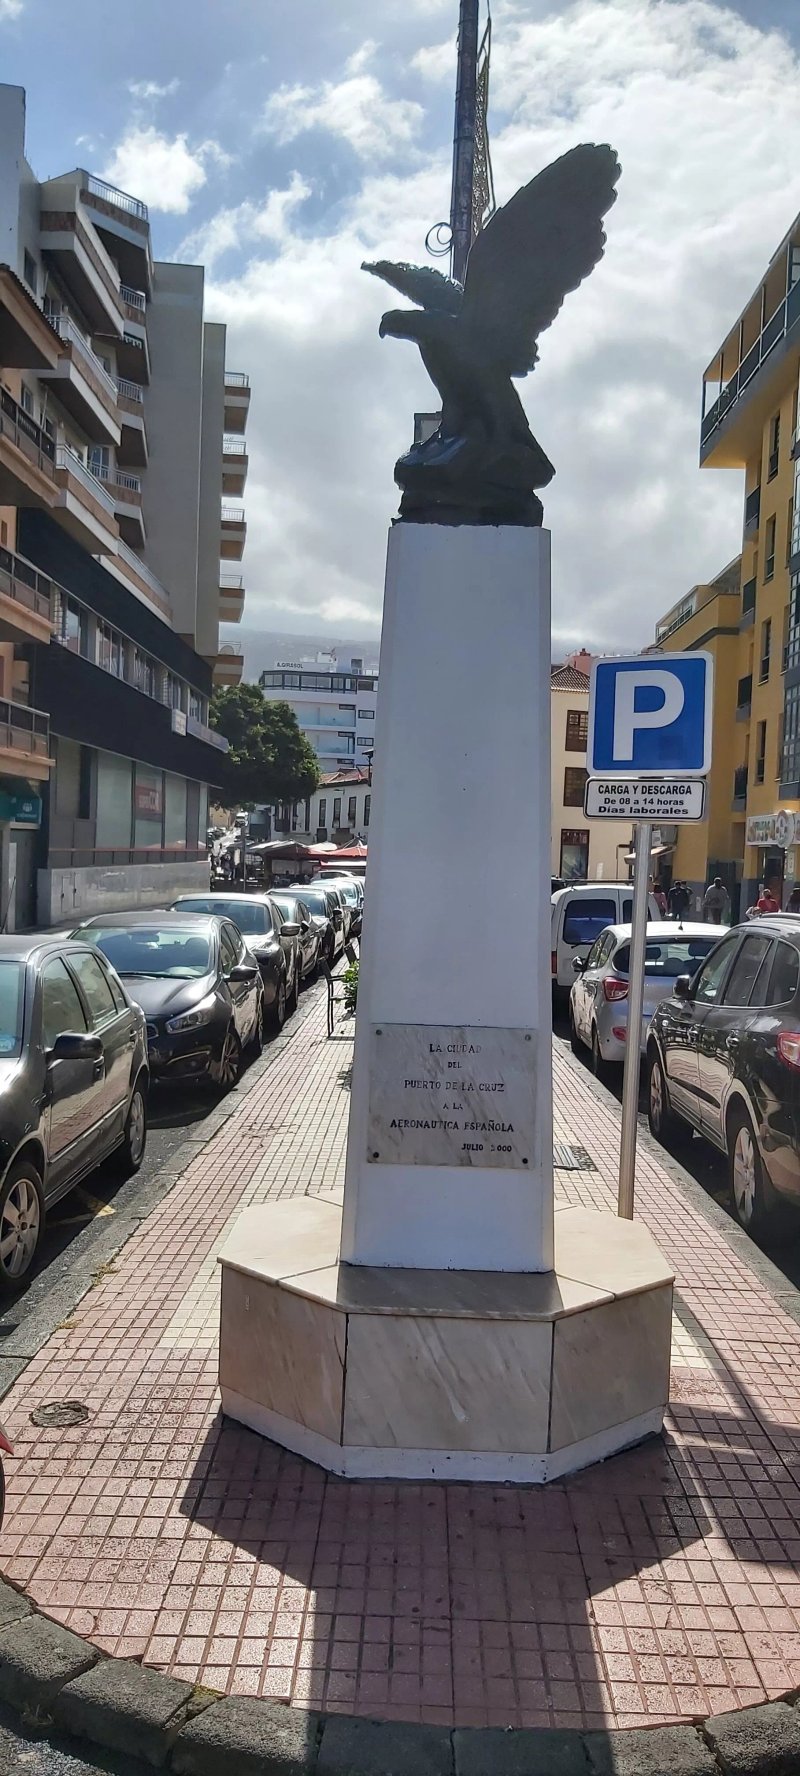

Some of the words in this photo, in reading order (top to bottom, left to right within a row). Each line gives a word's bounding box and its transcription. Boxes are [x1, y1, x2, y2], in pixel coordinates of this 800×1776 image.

[612, 669, 685, 761] P
[598, 785, 629, 794] CARGA
[632, 785, 639, 794] Y
[641, 785, 692, 795] DESCARGA
[657, 798, 684, 806] horas
[629, 806, 689, 815] laborales
[429, 1043, 443, 1053] LA
[446, 1044, 482, 1054] CIUDAD
[404, 1079, 441, 1090] PUERTO
[445, 1081, 457, 1090] DE
[461, 1082, 474, 1091] LA
[479, 1083, 505, 1092] CRUZ
[443, 1102, 449, 1110] A
[452, 1102, 463, 1110] LA
[390, 1119, 459, 1130] AERONAUTICA
[463, 1119, 514, 1132] ESPAÑOLA
[461, 1143, 484, 1151] JULIO
